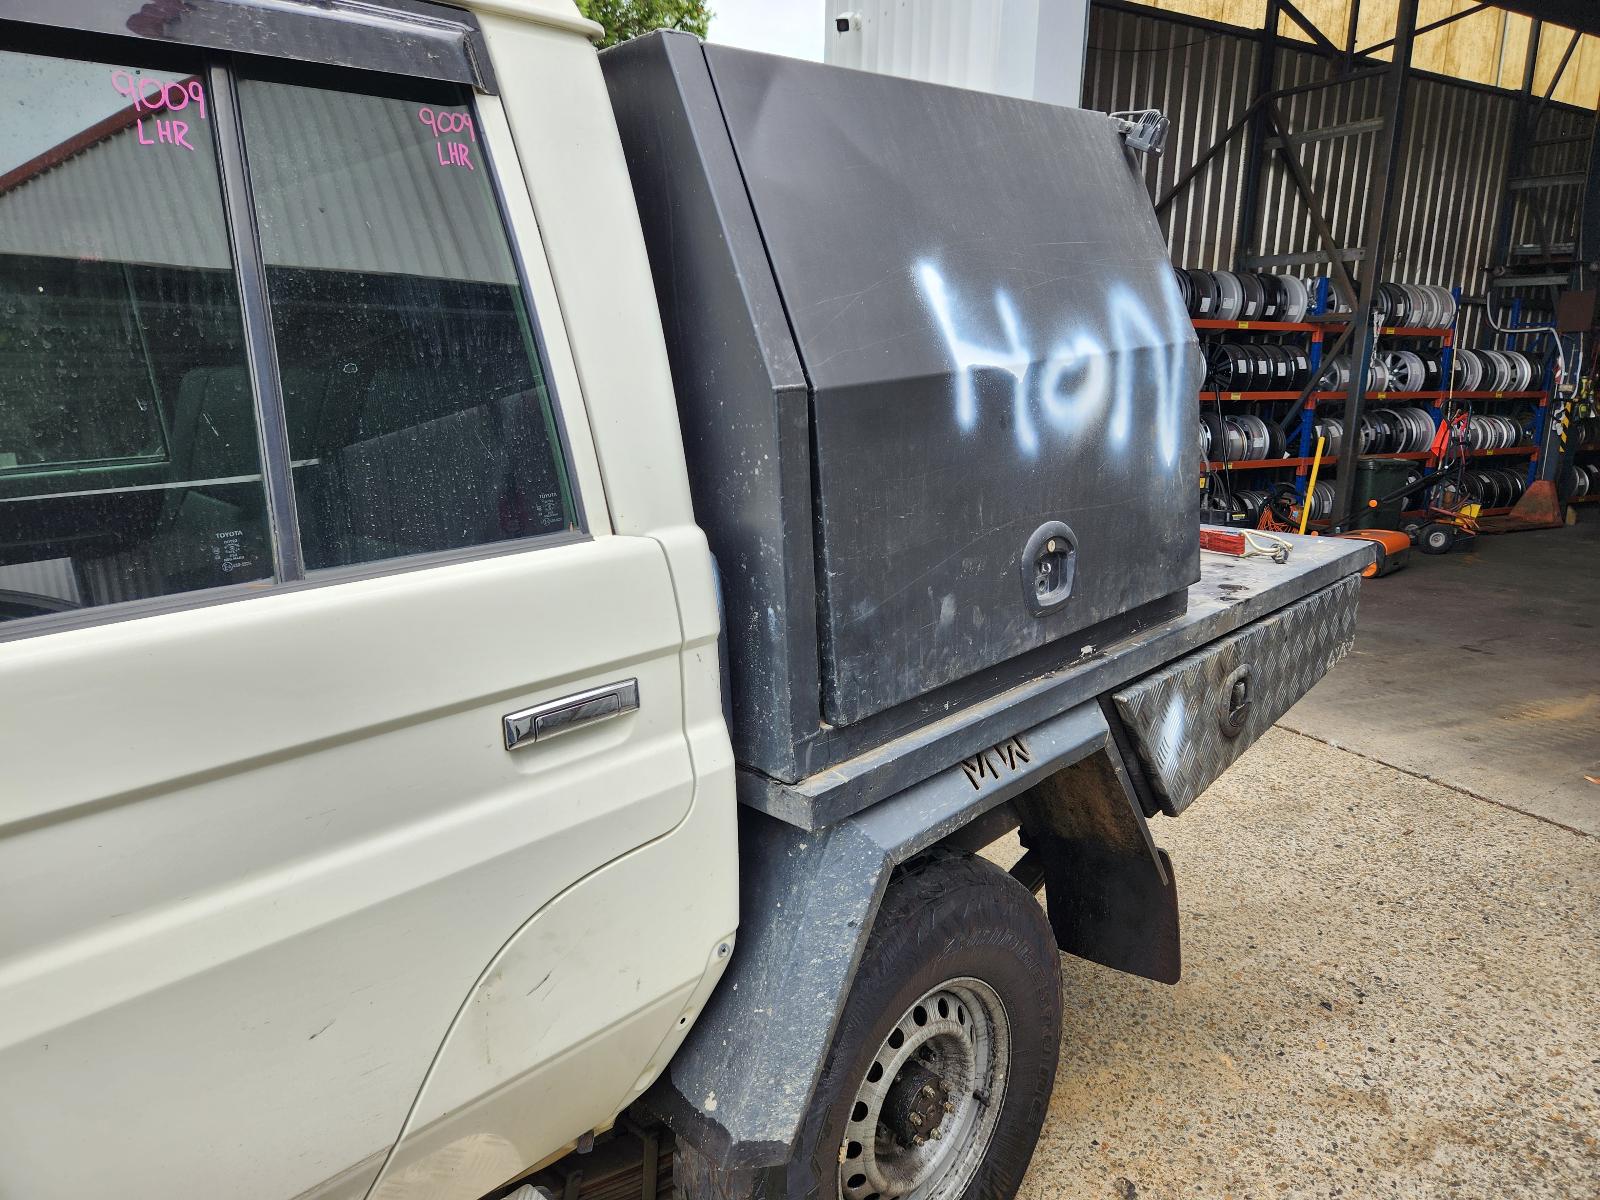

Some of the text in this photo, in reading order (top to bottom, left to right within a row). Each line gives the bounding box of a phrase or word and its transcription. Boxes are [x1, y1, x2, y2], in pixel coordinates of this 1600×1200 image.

[111, 70, 205, 119] 9009
[137, 118, 194, 150] LHR
[418, 107, 475, 142] 9009
[436, 142, 474, 171] LHR
[215, 530, 243, 539] TOYOTA
